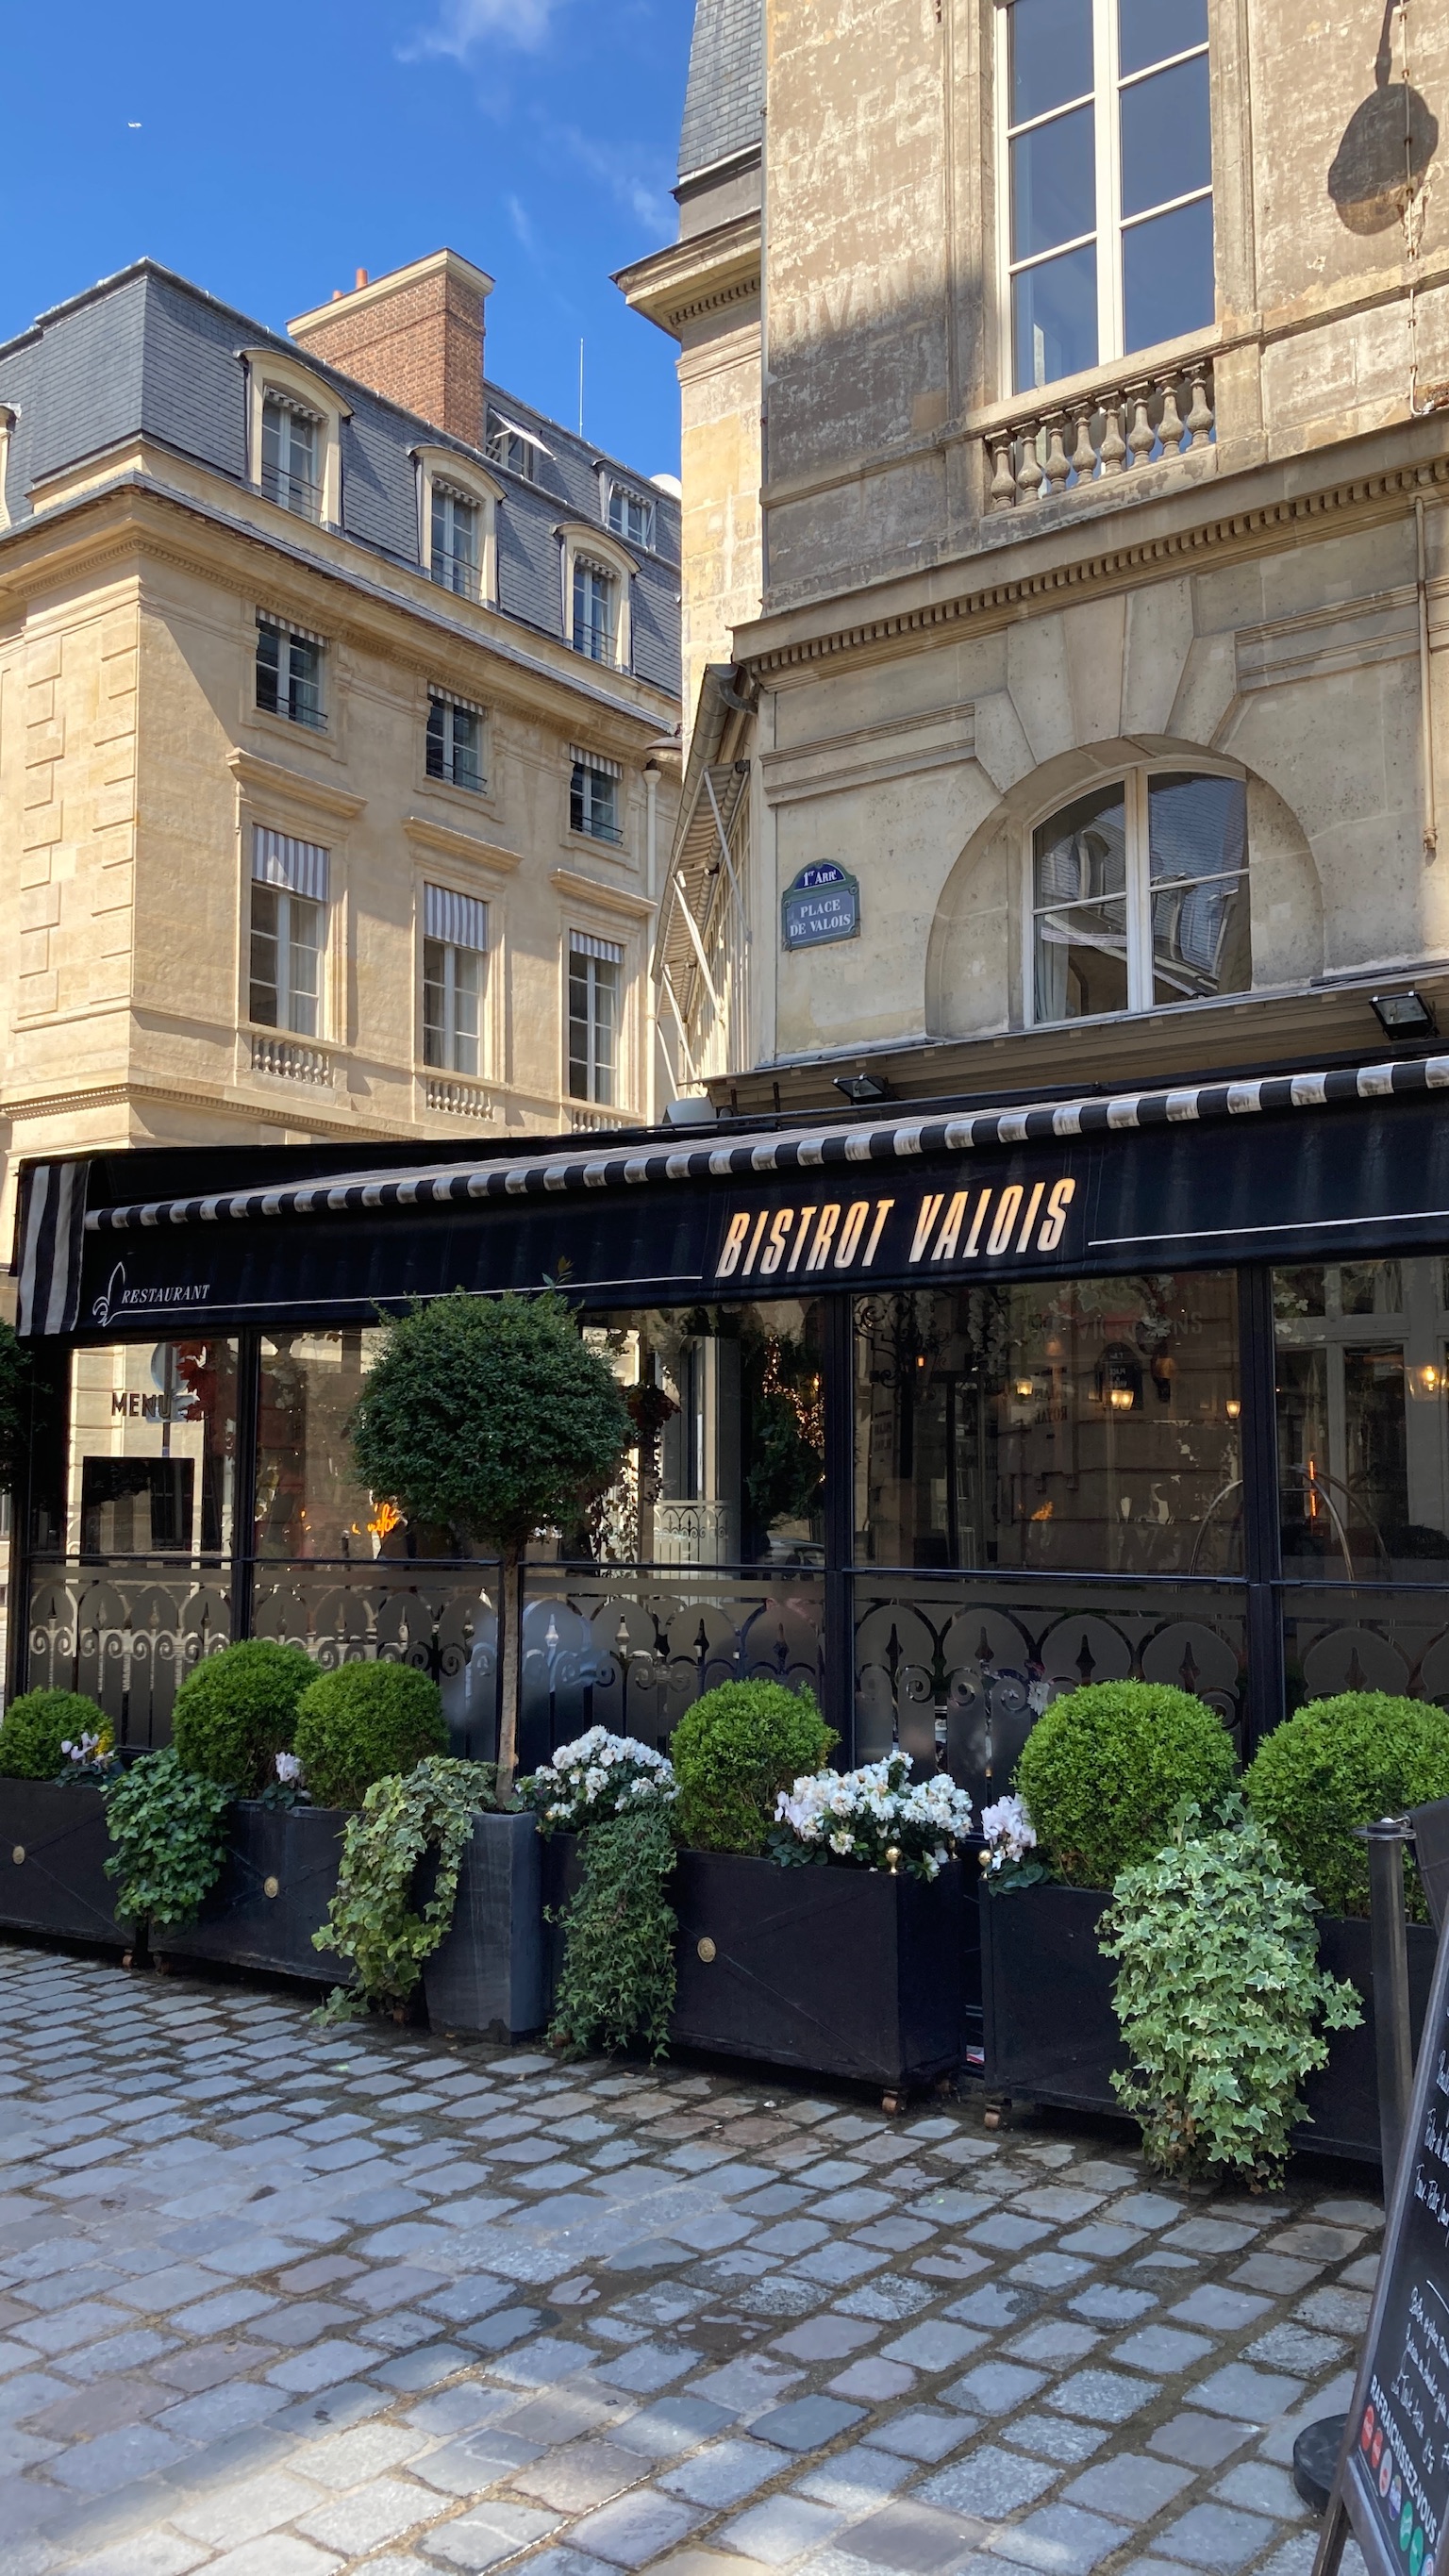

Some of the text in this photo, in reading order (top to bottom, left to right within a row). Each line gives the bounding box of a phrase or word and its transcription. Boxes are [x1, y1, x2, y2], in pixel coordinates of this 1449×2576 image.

[800, 899, 841, 919] PLACE
[790, 913, 851, 937] DE VALOIS
[715, 1177, 1076, 1278] BISTROT VALOIS
[121, 1284, 210, 1305] RESTAURANT
[111, 1392, 172, 1418] MENU
